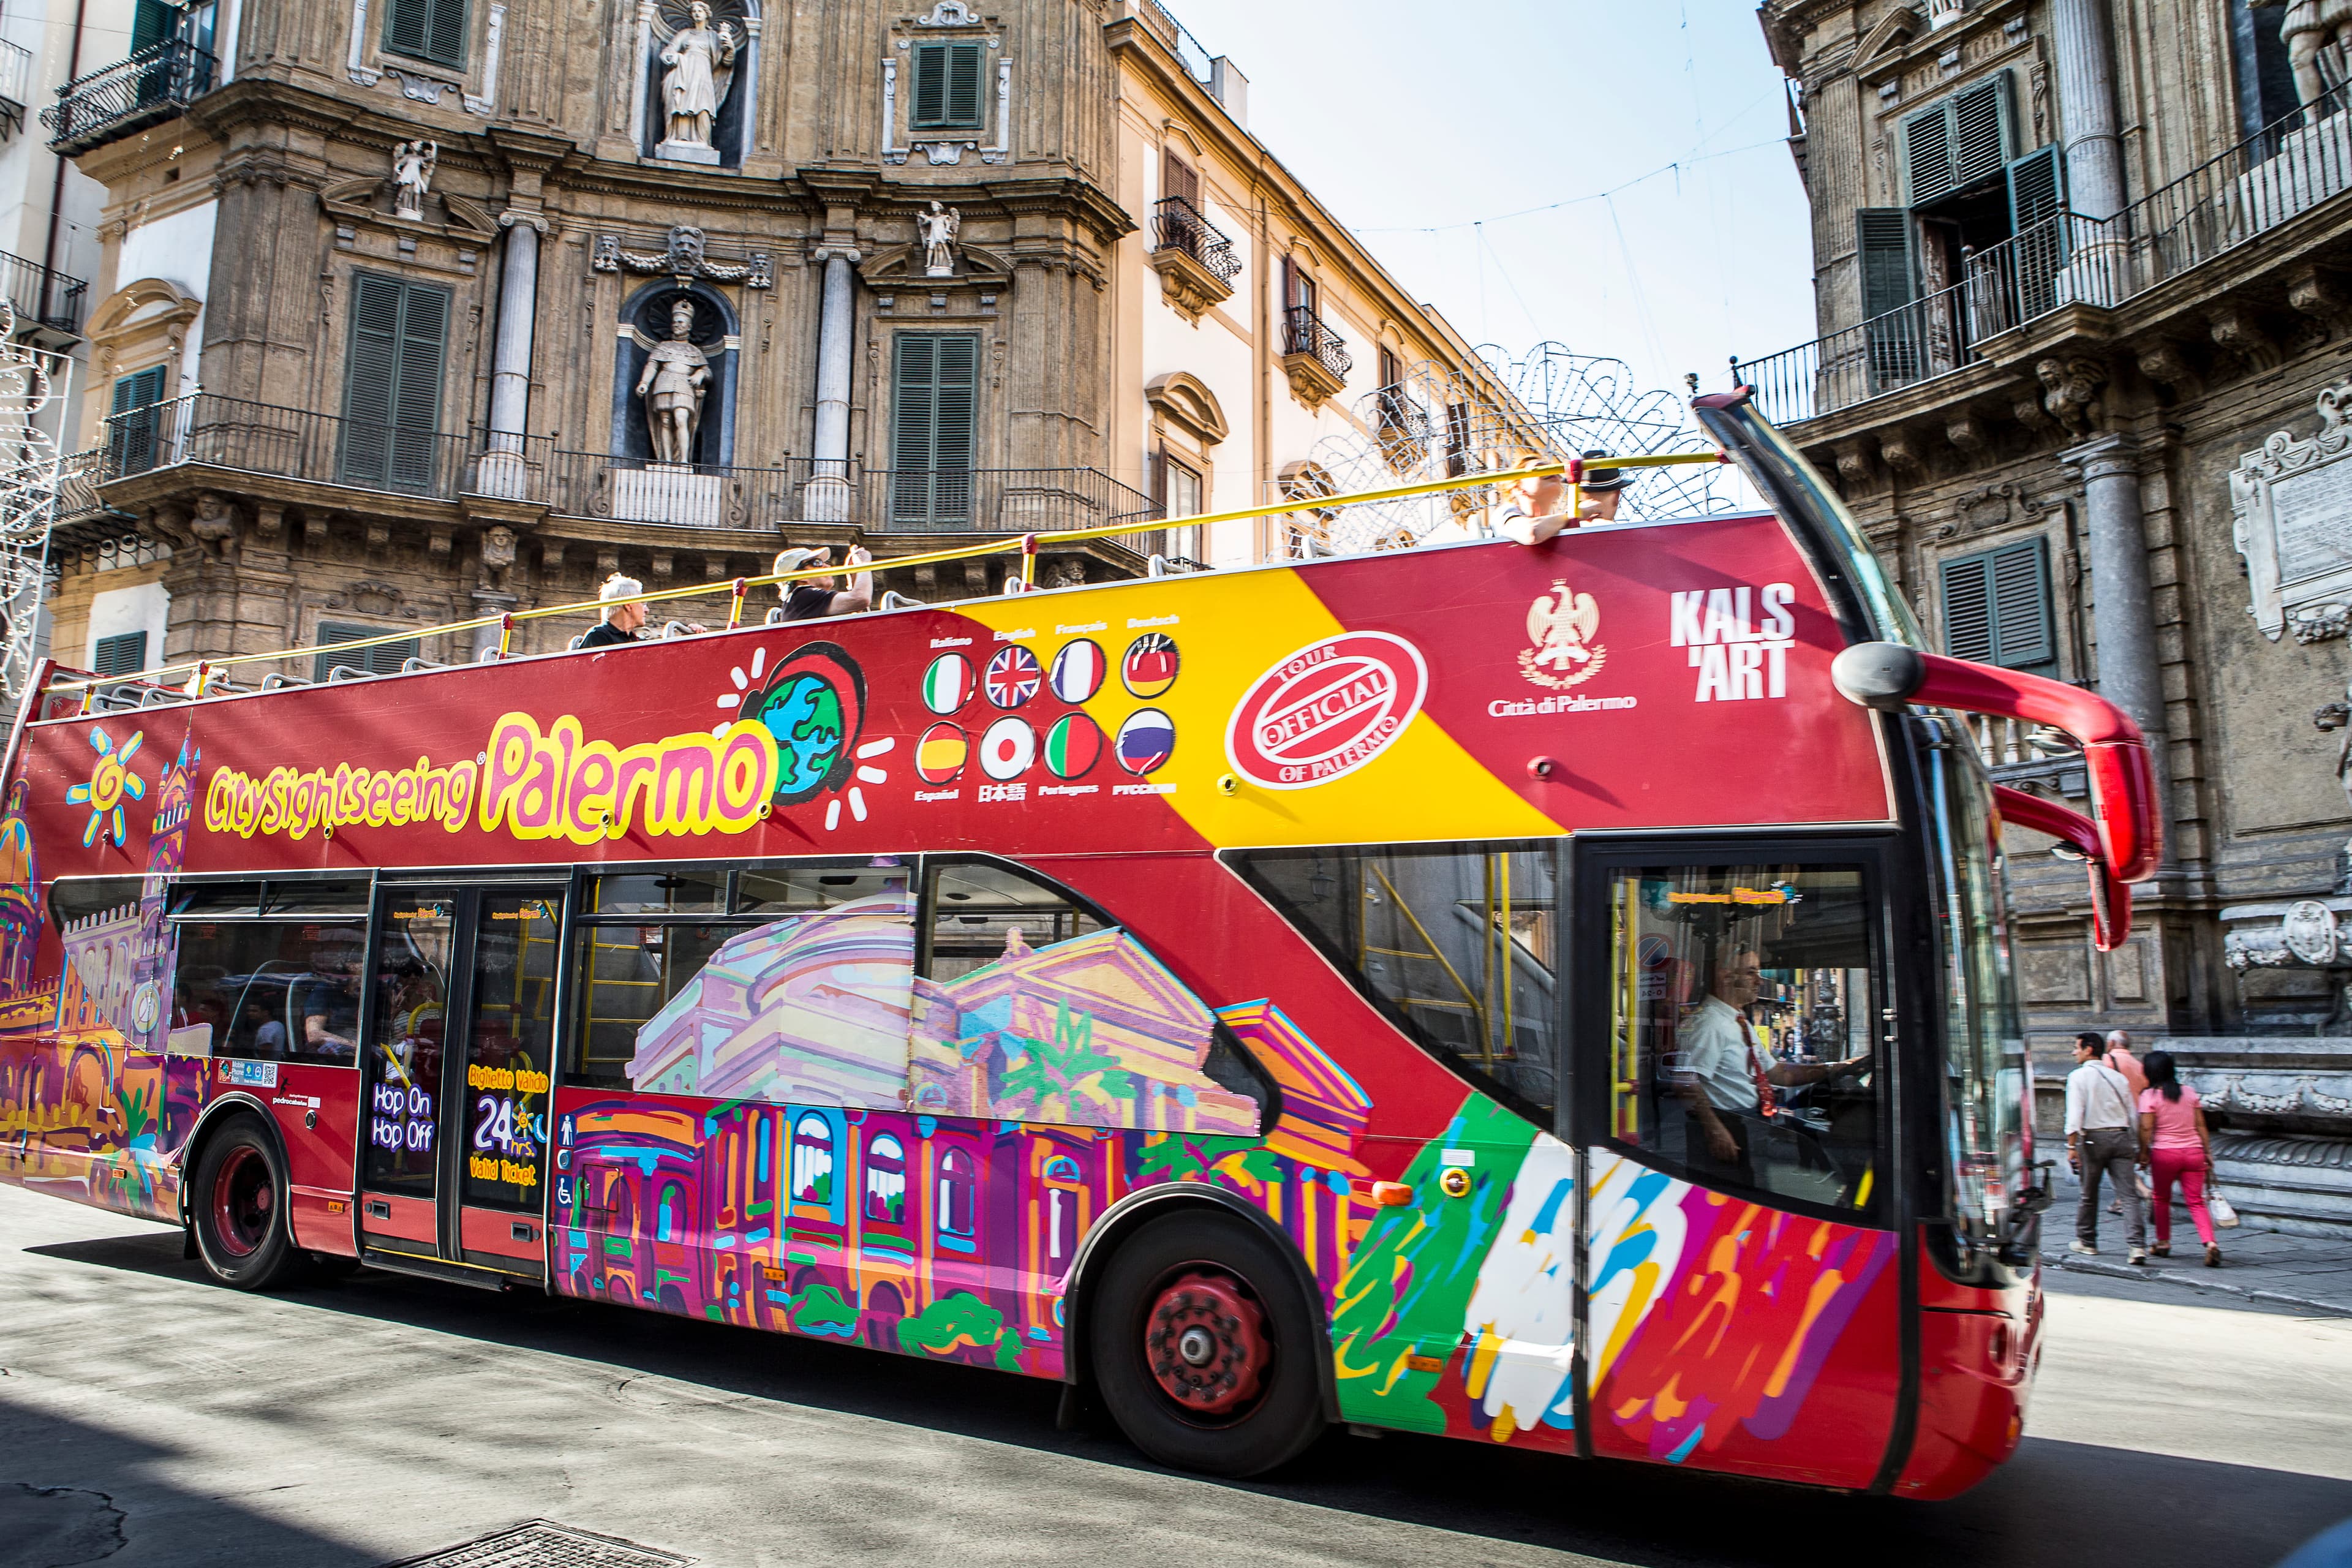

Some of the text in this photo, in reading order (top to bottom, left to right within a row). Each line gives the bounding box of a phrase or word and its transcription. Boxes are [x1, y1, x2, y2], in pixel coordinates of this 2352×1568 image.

[1055, 620, 1107, 635] Français
[1127, 614, 1180, 628] Deutsch
[1670, 582, 1795, 647] KALS
[930, 637, 972, 648] Italiano
[993, 628, 1036, 641] English
[1273, 646, 1339, 682] TOUR
[1261, 673, 1388, 747] OFFICIAL
[1488, 694, 1637, 717] Città di Palermo
[1278, 716, 1399, 782] OF PALERMO
[480, 712, 778, 844] Palermo
[978, 783, 1027, 802] 日本語
[914, 788, 959, 802] Español
[469, 1064, 548, 1093] Biglietto Valido
[374, 1084, 430, 1117] Hop On
[372, 1118, 434, 1150] Hop Off
[475, 1096, 512, 1152] 24
[470, 1157, 536, 1185] Valid Ticket
